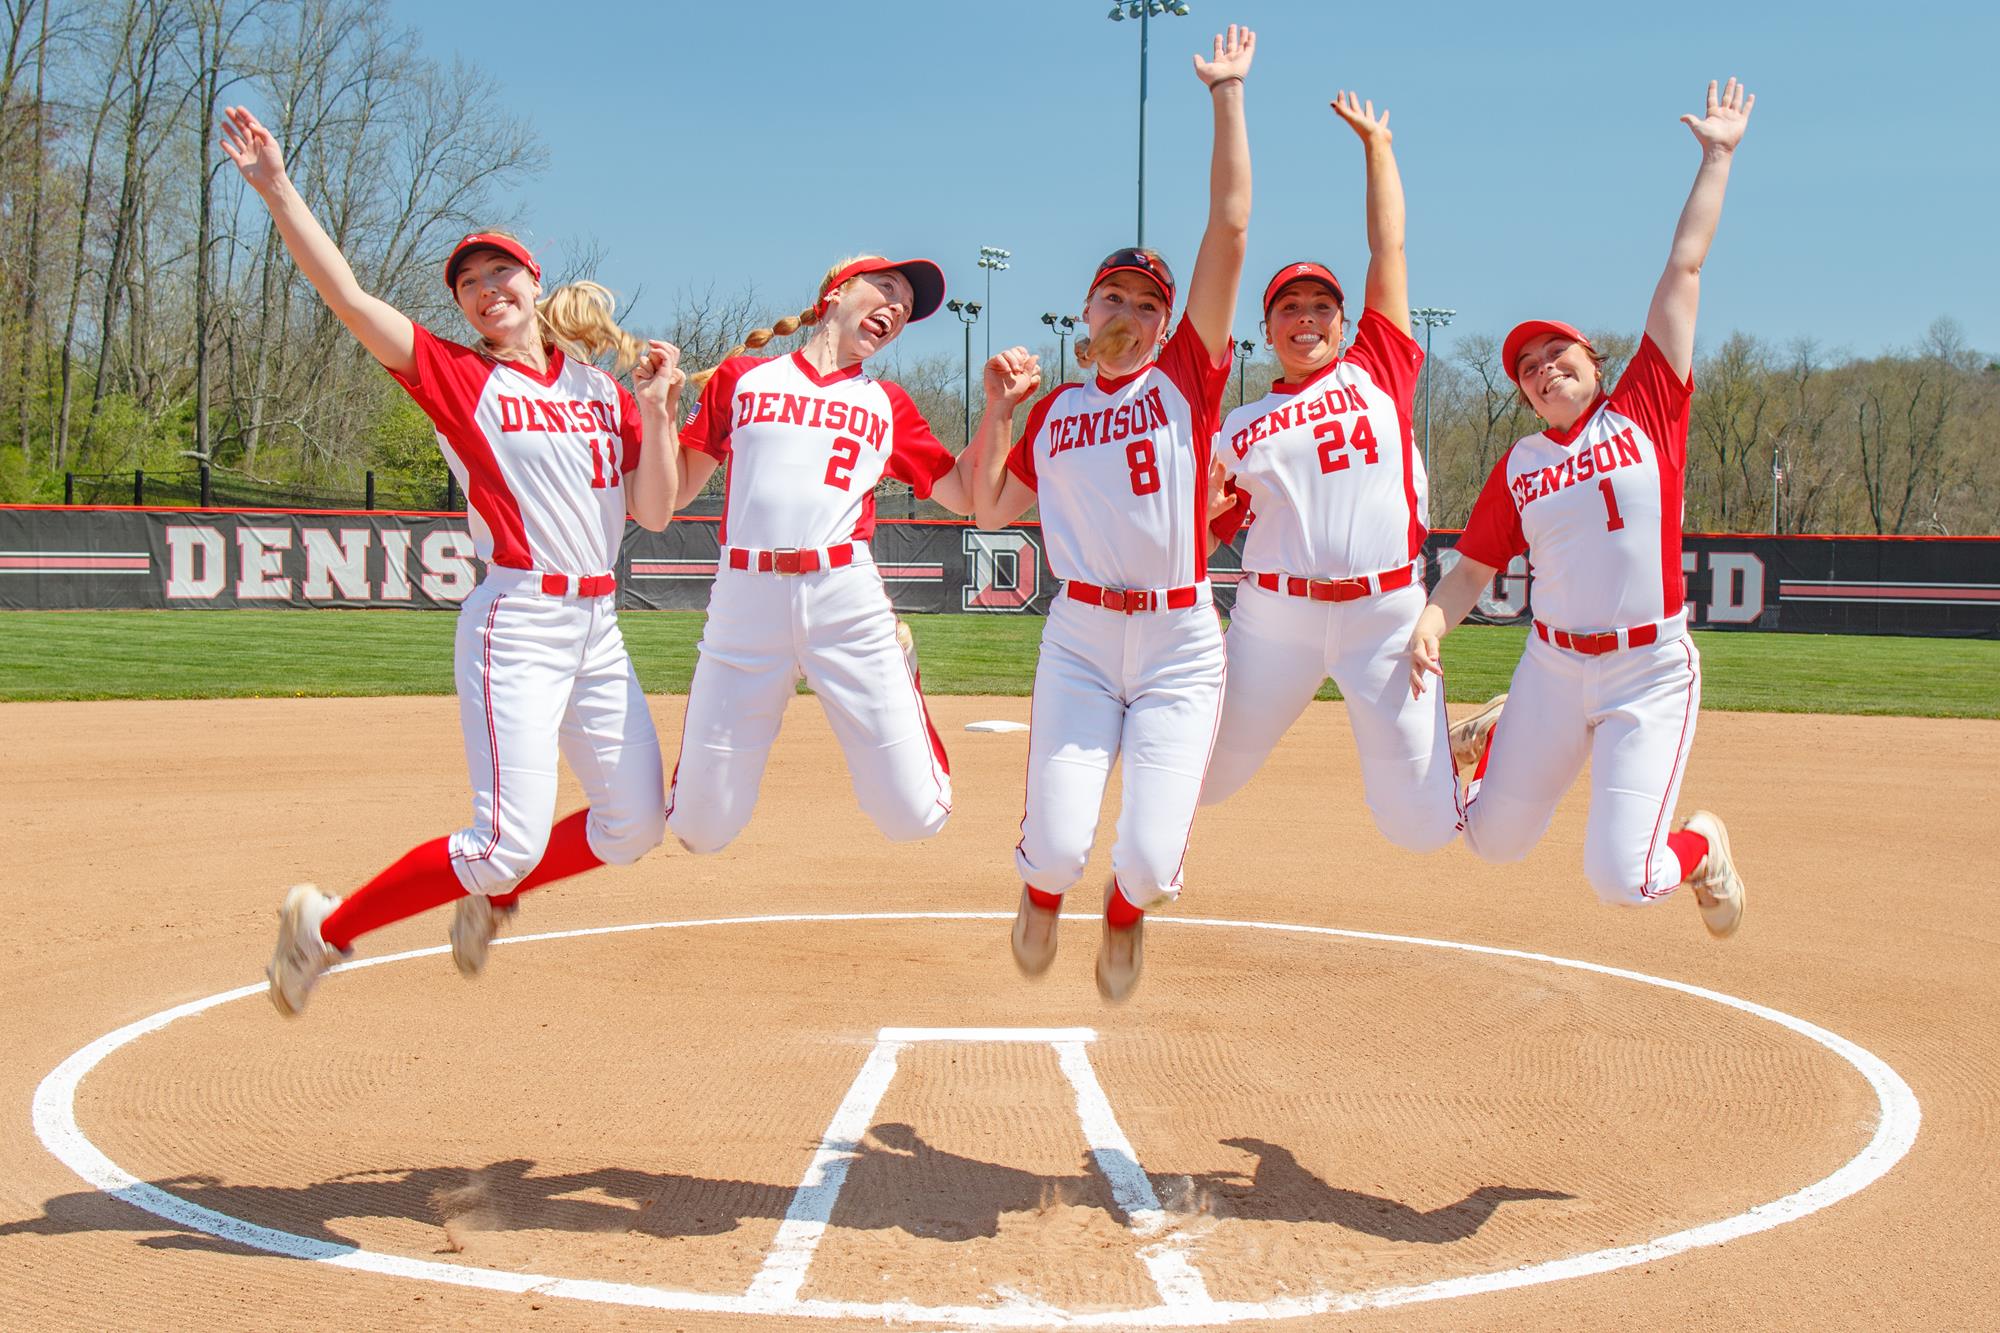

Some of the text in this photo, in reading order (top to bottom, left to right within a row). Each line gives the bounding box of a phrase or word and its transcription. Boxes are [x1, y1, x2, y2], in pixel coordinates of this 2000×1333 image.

[737, 391, 889, 452] DENISON
[1049, 386, 1169, 458] DENISON
[1231, 383, 1369, 461] DENISON
[1313, 415, 1379, 475] 24
[589, 438, 620, 488] 11
[823, 436, 861, 492] 2
[1125, 438, 1161, 496] 8
[1511, 427, 1643, 512] DENISON
[1598, 477, 1625, 532] 1
[165, 525, 487, 600] DENIS
[963, 529, 1040, 611] D
